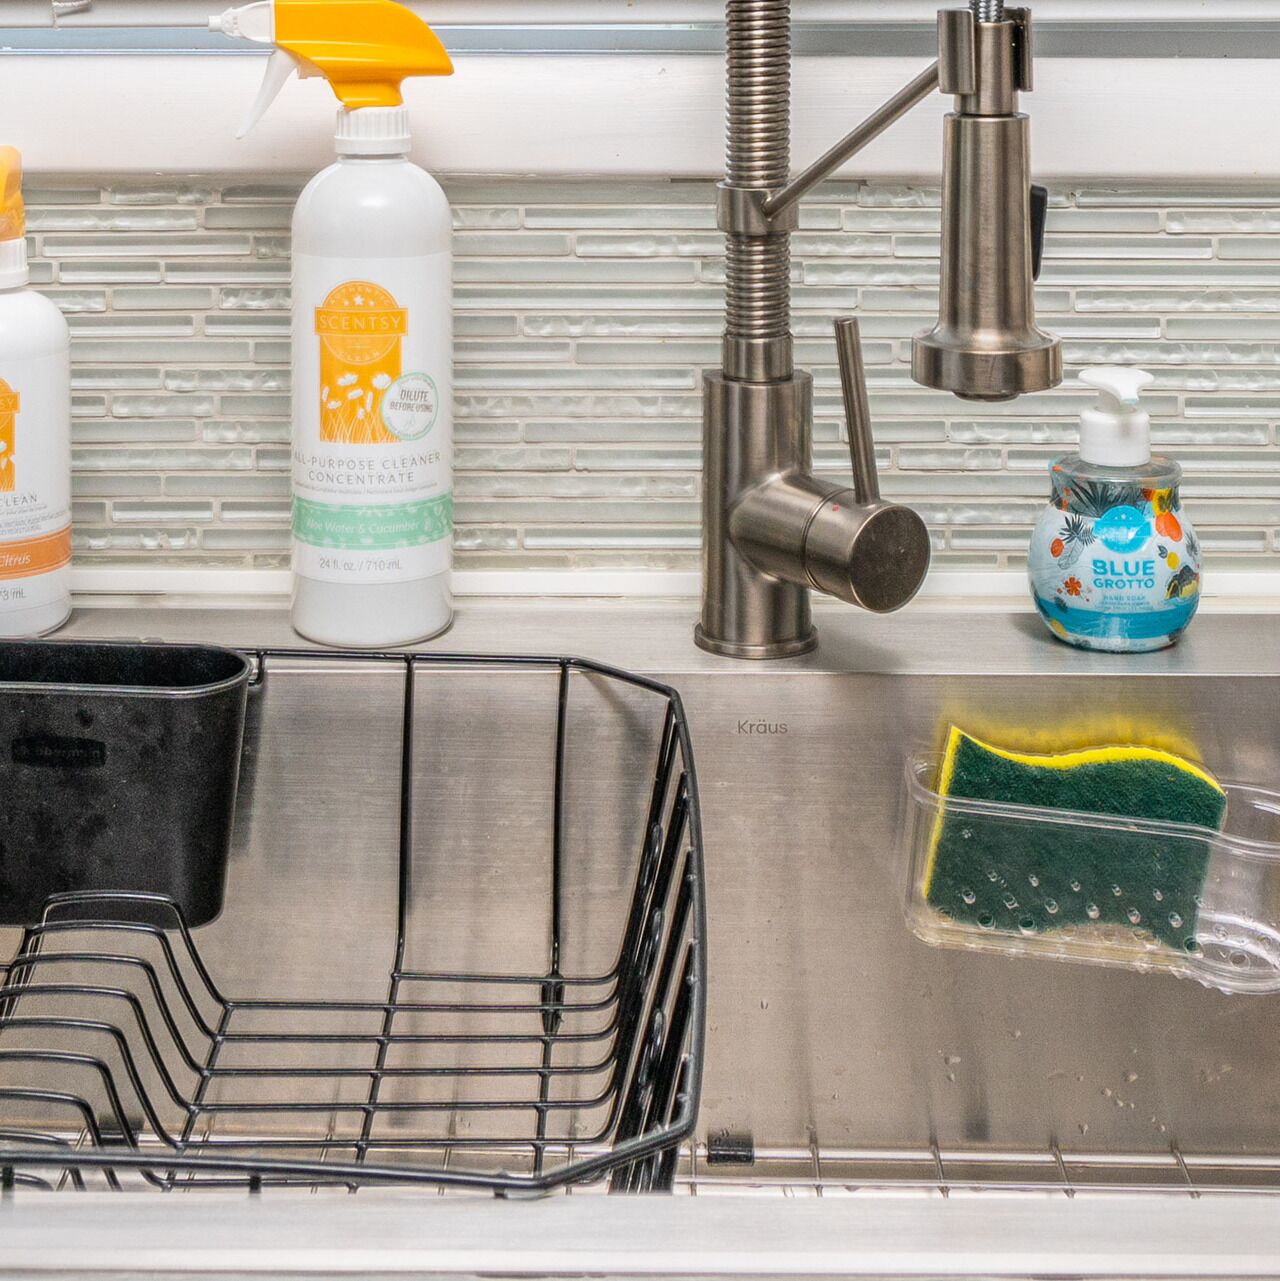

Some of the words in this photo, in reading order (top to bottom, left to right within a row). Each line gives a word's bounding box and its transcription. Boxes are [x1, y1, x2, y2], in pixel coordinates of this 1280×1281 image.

[320, 315, 401, 330] SCENTSY
[400, 389, 429, 402] DILUTE
[389, 401, 415, 412] BEFORE
[382, 452, 441, 469] CLEANER
[308, 471, 415, 486] CONCENTRATE
[325, 521, 355, 533] Water
[320, 558, 331, 569] 24
[1092, 560, 1155, 576] BLUE
[1093, 579, 1155, 590] GROTTO
[737, 719, 788, 734] Kräus
